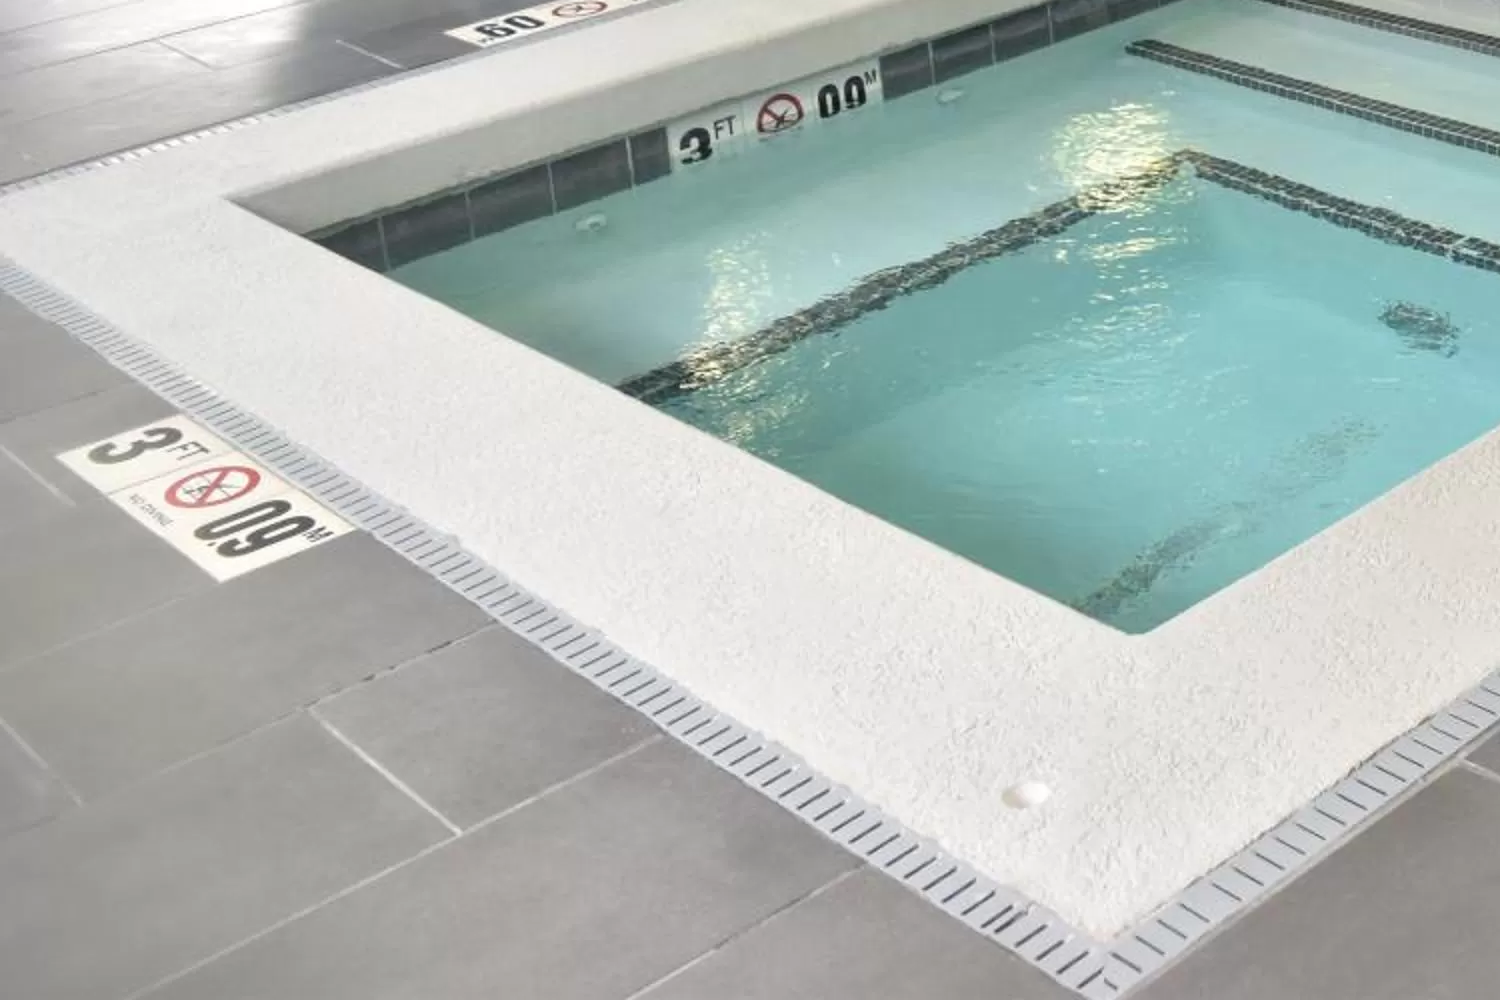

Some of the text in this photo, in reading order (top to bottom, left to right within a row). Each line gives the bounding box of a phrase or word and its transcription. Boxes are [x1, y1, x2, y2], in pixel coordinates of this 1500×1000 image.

[679, 126, 713, 165] 3
[713, 115, 737, 140] FT
[87, 426, 184, 465] 3
[167, 441, 210, 461] FT
